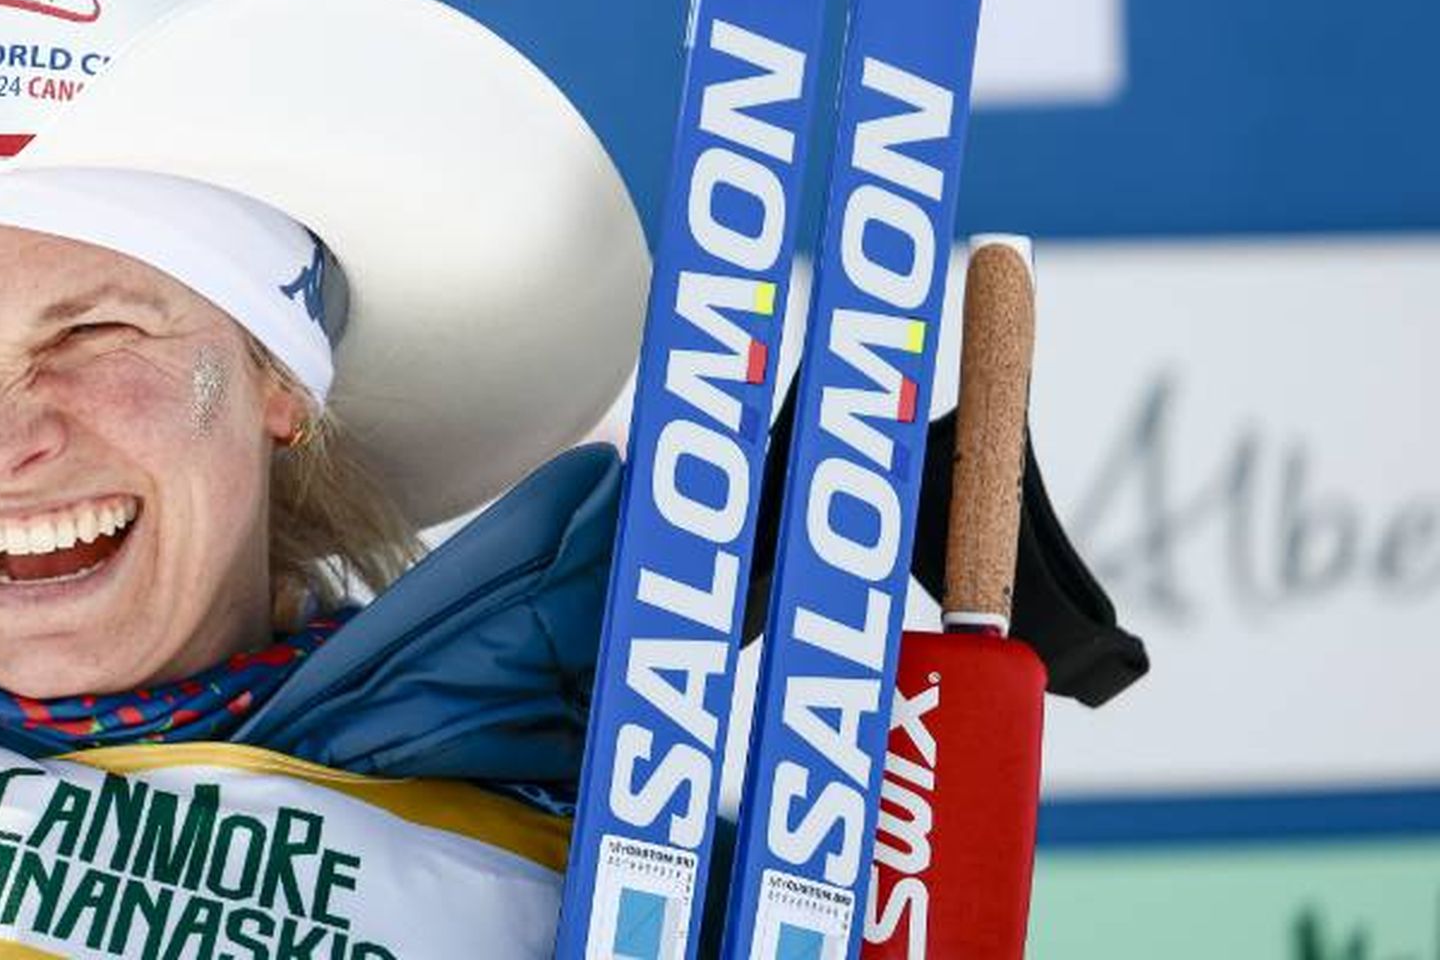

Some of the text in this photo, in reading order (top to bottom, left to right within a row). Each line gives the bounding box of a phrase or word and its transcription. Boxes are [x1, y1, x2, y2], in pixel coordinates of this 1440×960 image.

[27, 75, 85, 102] CAN
[80, 53, 111, 77] C
[608, 19, 807, 850] SALOMON
[767, 56, 956, 888] SALOMON
